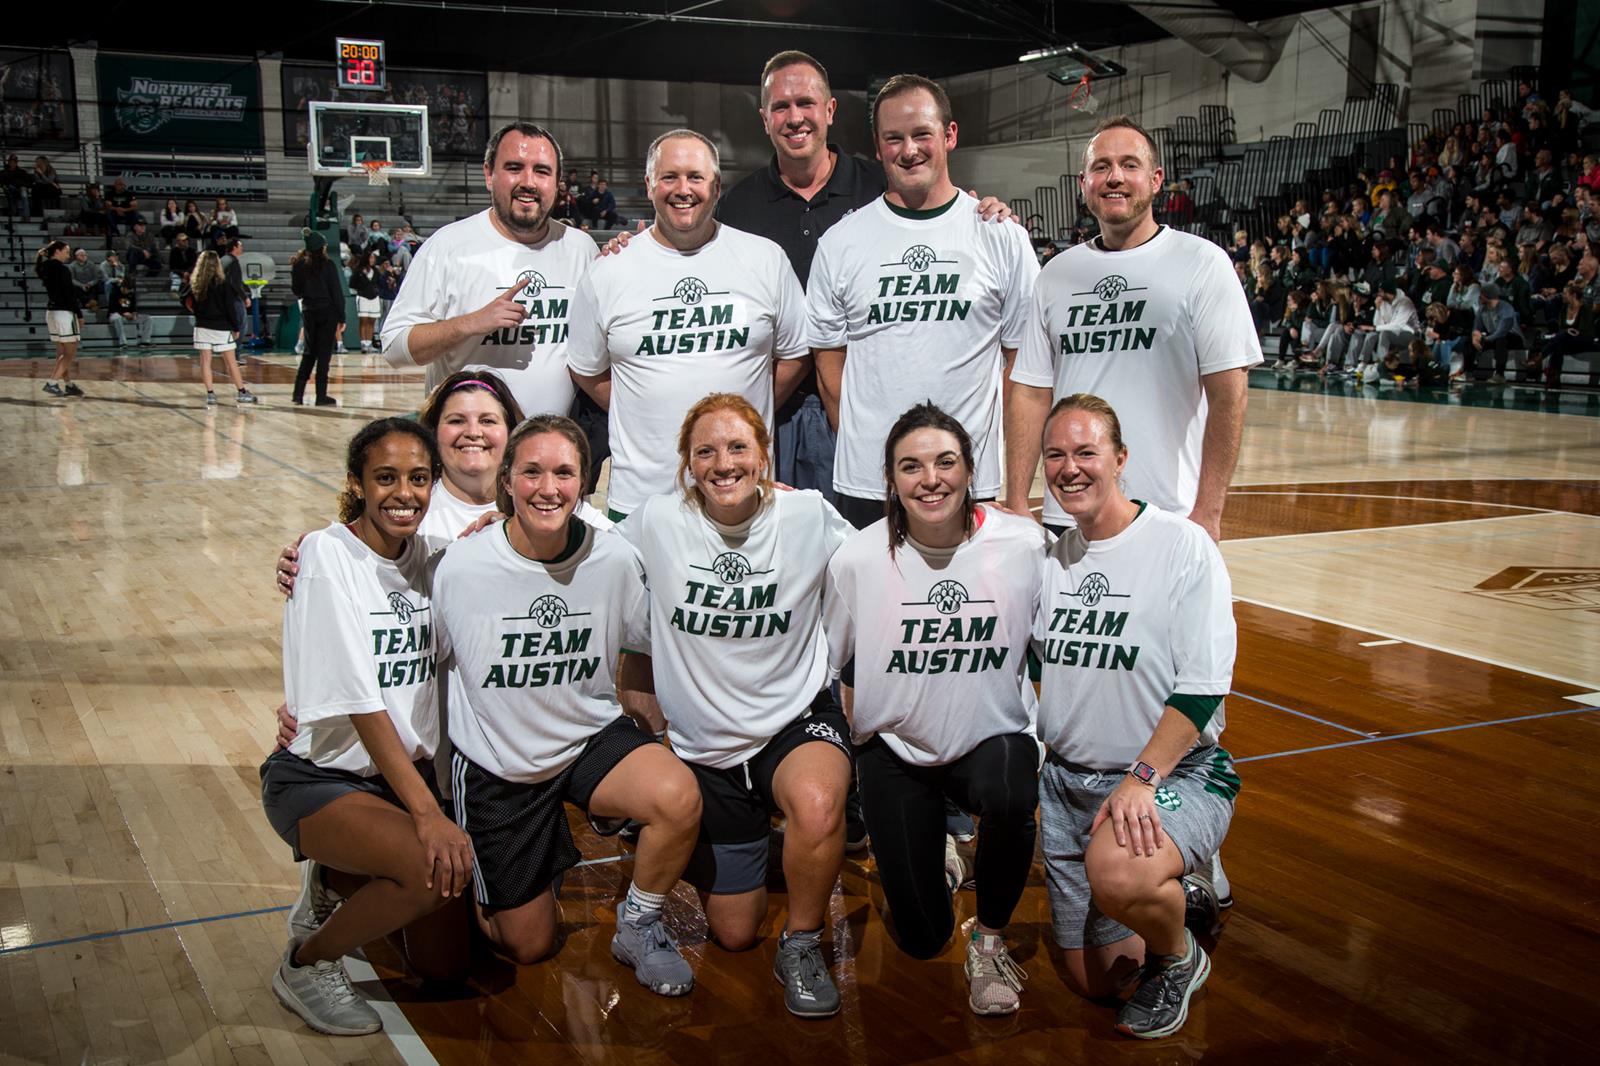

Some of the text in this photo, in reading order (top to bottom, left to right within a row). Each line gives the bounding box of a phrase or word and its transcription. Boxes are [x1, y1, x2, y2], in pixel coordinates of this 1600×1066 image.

[342, 45, 378, 60] 20:00
[133, 79, 230, 98] NORTHWEST
[160, 95, 244, 109] BEARCATS
[877, 272, 961, 298] TEAM
[514, 298, 569, 320] AM
[651, 303, 735, 332] TEAM
[866, 299, 972, 325] AUSTIN
[1066, 299, 1148, 328] TEAM
[634, 326, 751, 357] AUSTIN
[1058, 327, 1158, 355] AUSTIN
[684, 580, 779, 612] TEAM
[670, 606, 793, 640] AUSTIN
[900, 615, 998, 645] TEAM
[1048, 607, 1130, 638] TEAM
[371, 622, 432, 656] TEAM
[501, 627, 593, 658] TEAM
[885, 646, 1010, 675] AUSTIN
[1043, 638, 1141, 672] USTIN
[377, 652, 438, 689] USTIN
[481, 656, 602, 690] AUSTIN
